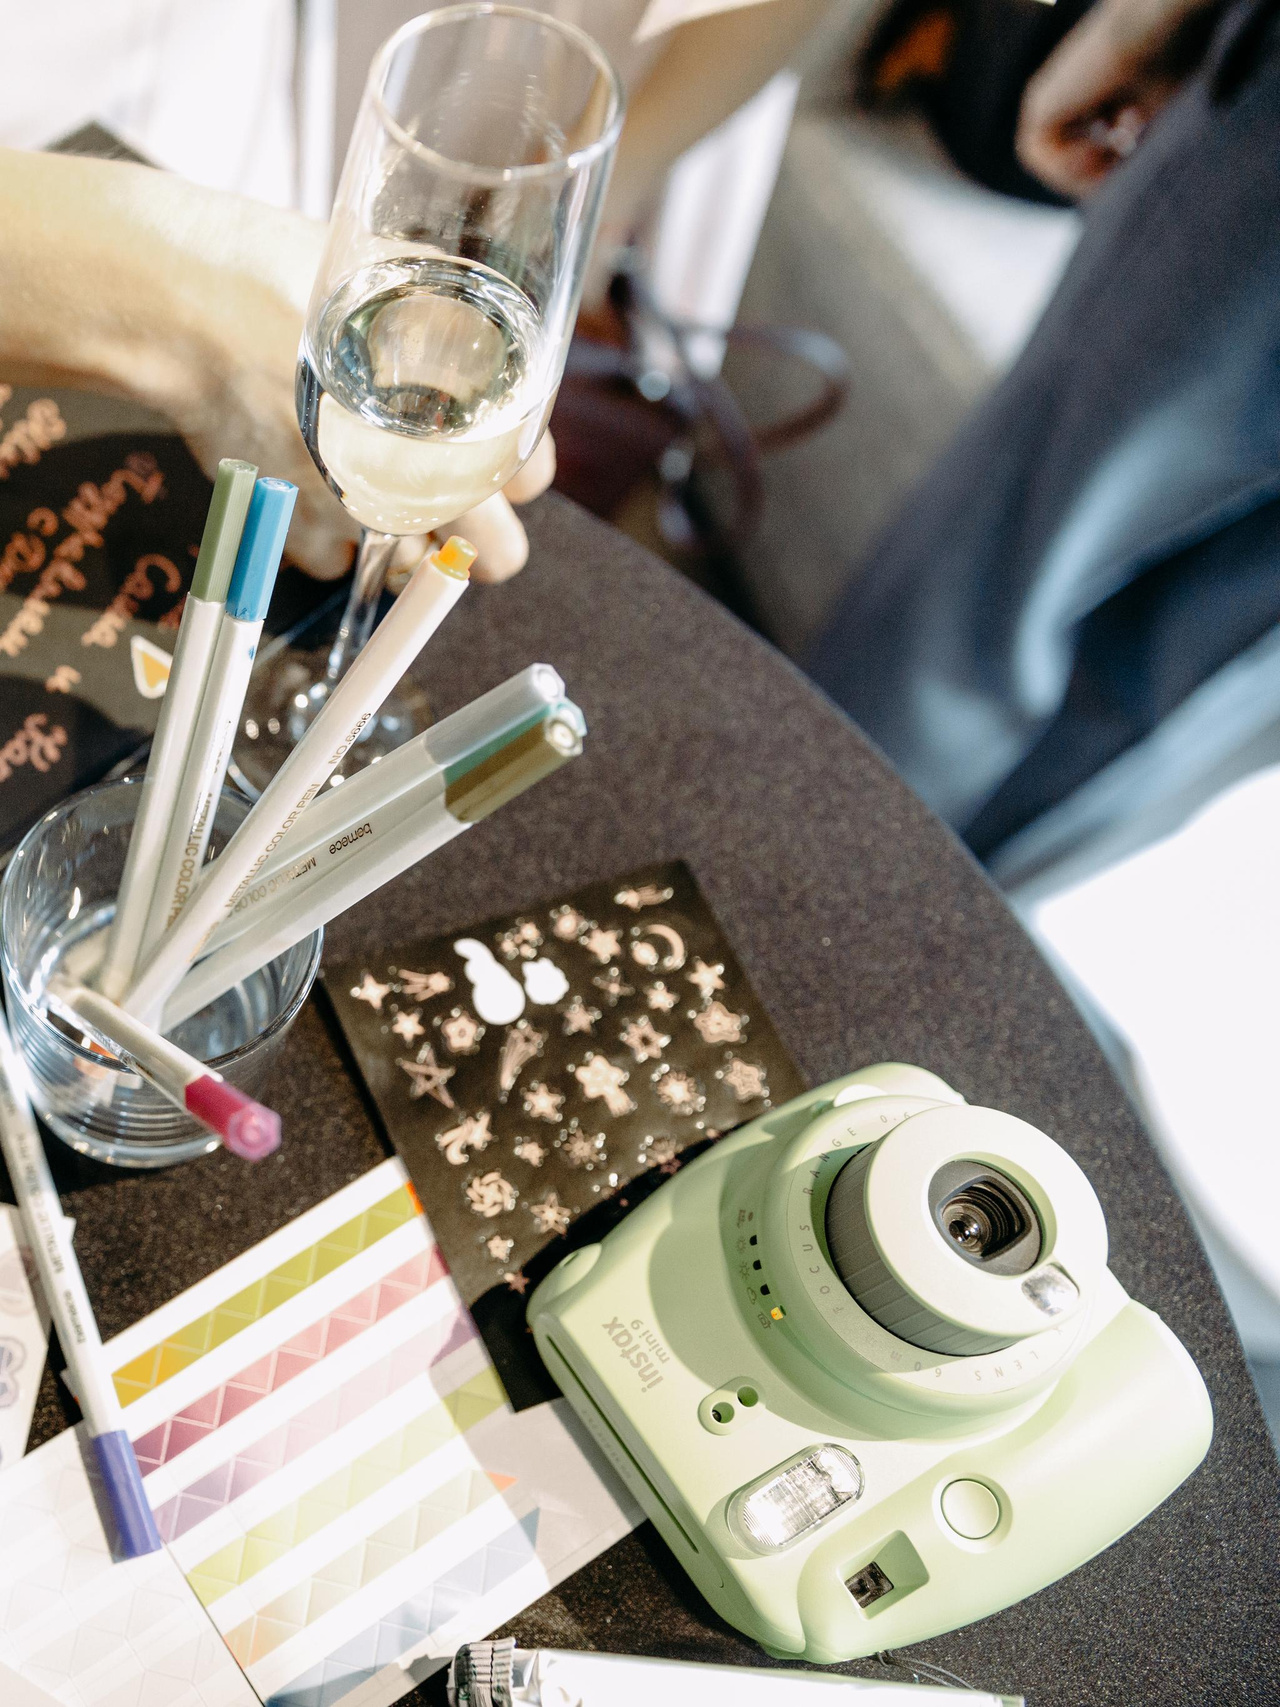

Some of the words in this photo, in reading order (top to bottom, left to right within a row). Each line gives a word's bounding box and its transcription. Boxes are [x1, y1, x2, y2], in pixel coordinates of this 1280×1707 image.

[223, 849, 271, 911] METALLIC
[263, 807, 301, 855] COLOR
[294, 780, 321, 811] PEN
[171, 856, 196, 904] COLOR
[802, 1127, 856, 1194] RANGE
[799, 1223, 845, 1315] FOCUS
[628, 1318, 643, 1330] 9
[638, 1329, 670, 1364] mini
[600, 1315, 664, 1393] instax
[974, 1350, 1039, 1381] LENS
